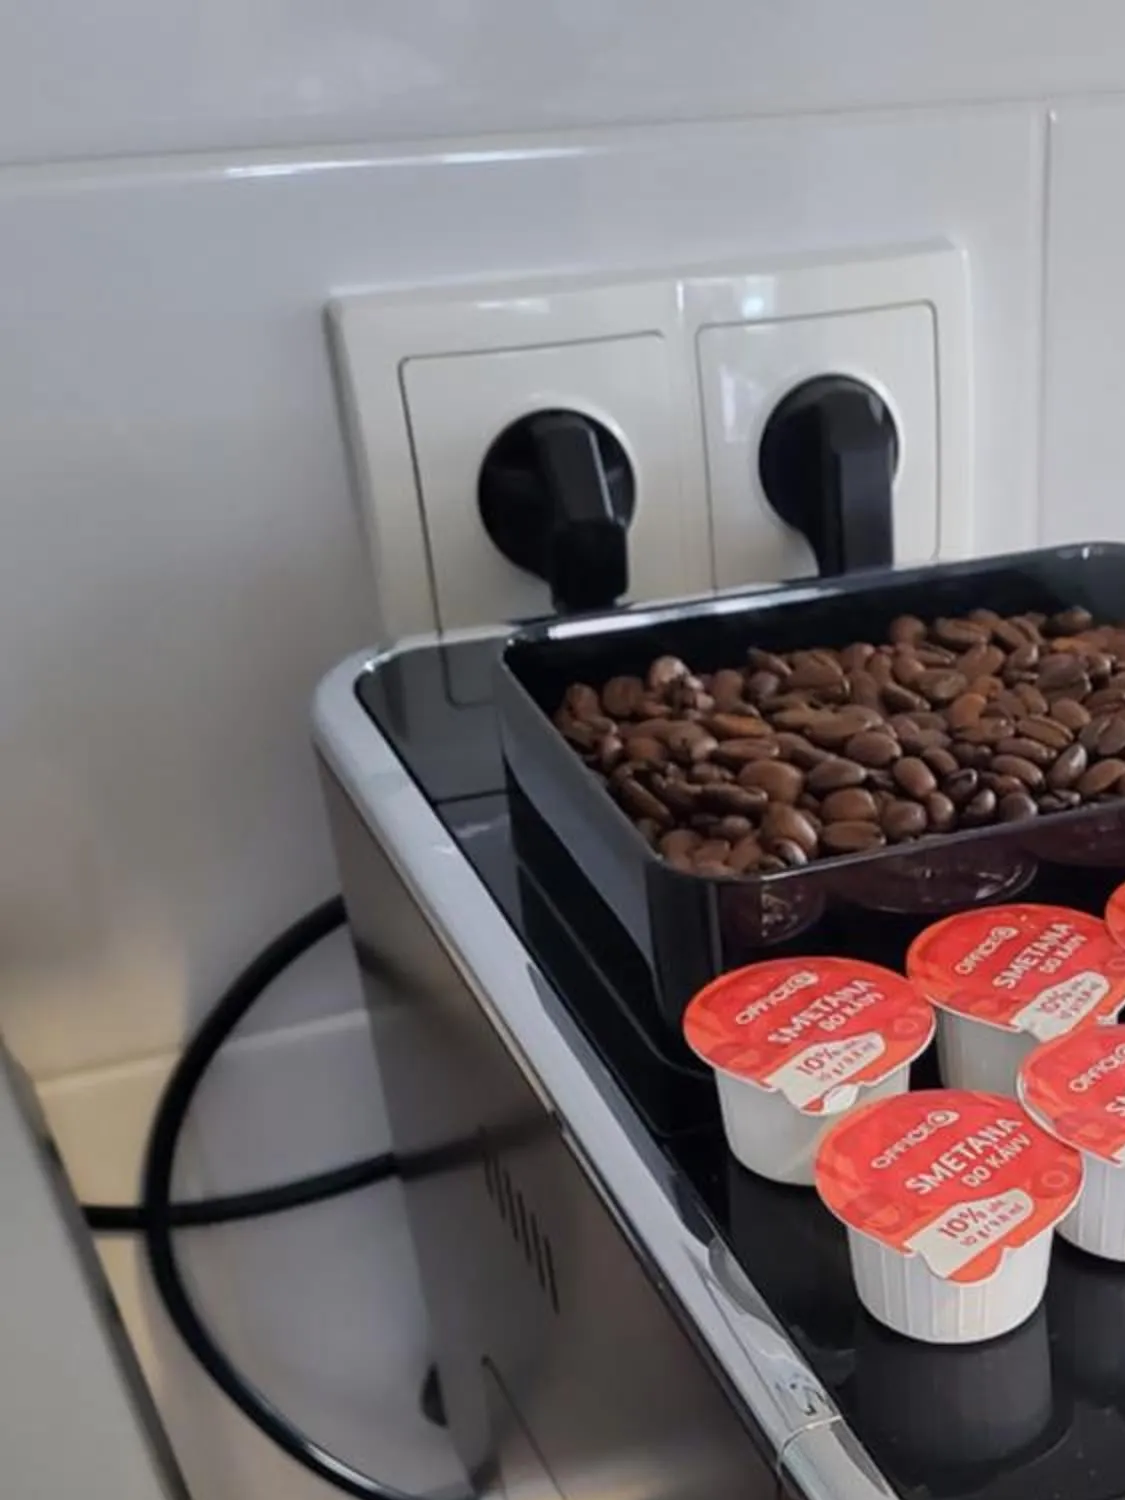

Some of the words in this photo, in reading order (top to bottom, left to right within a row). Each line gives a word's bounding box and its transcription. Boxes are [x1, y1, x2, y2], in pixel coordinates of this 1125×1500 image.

[992, 923, 1074, 989] SMETANA
[768, 979, 877, 1044] SMETANA
[904, 1117, 1023, 1195] SMETANA
[961, 1166, 992, 1187] DO
[938, 1206, 987, 1239] 10%
